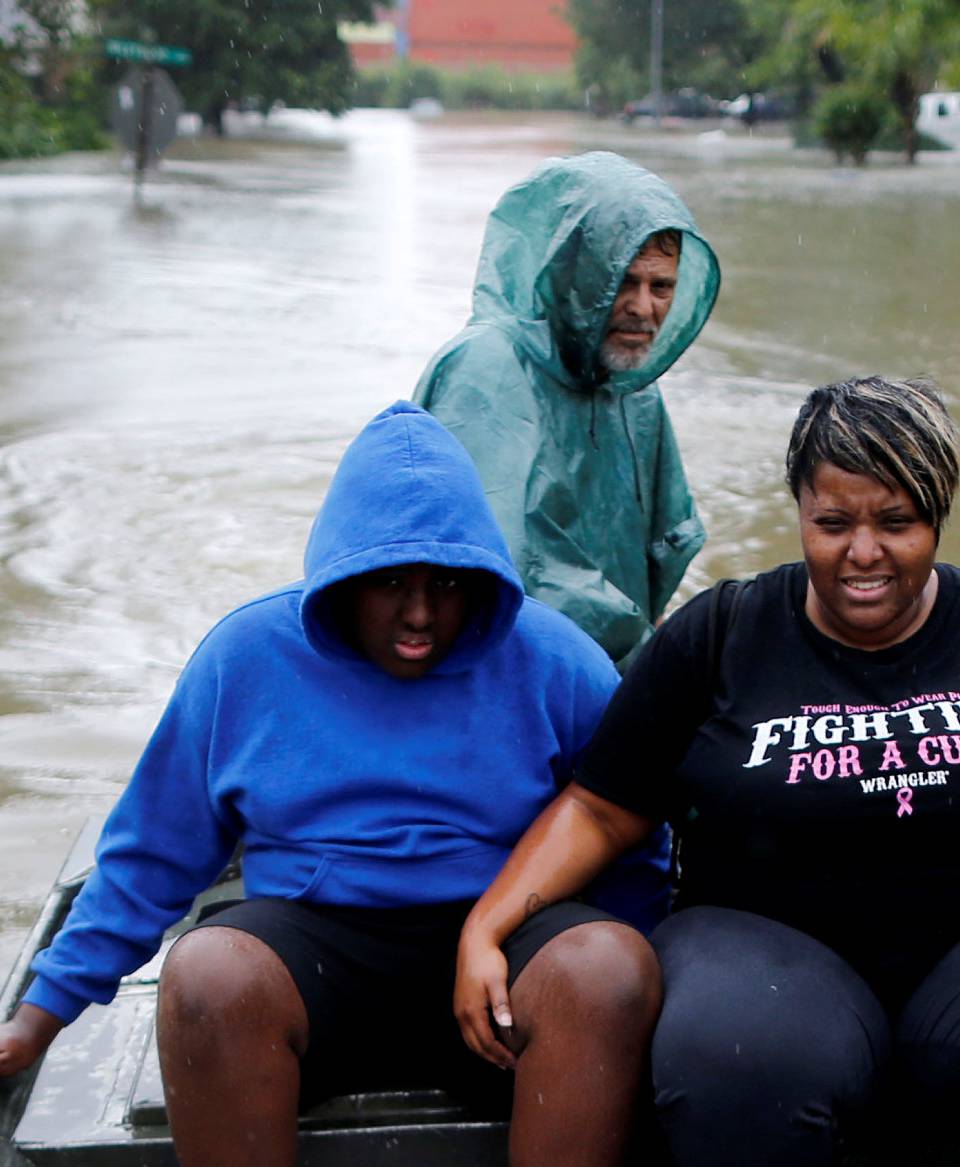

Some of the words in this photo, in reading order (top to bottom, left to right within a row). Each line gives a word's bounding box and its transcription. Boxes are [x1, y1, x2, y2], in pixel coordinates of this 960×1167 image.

[912, 693, 946, 706] WEAR
[785, 745, 863, 784] FOR
[878, 740, 907, 771] A
[860, 770, 947, 793] WRANGLER
